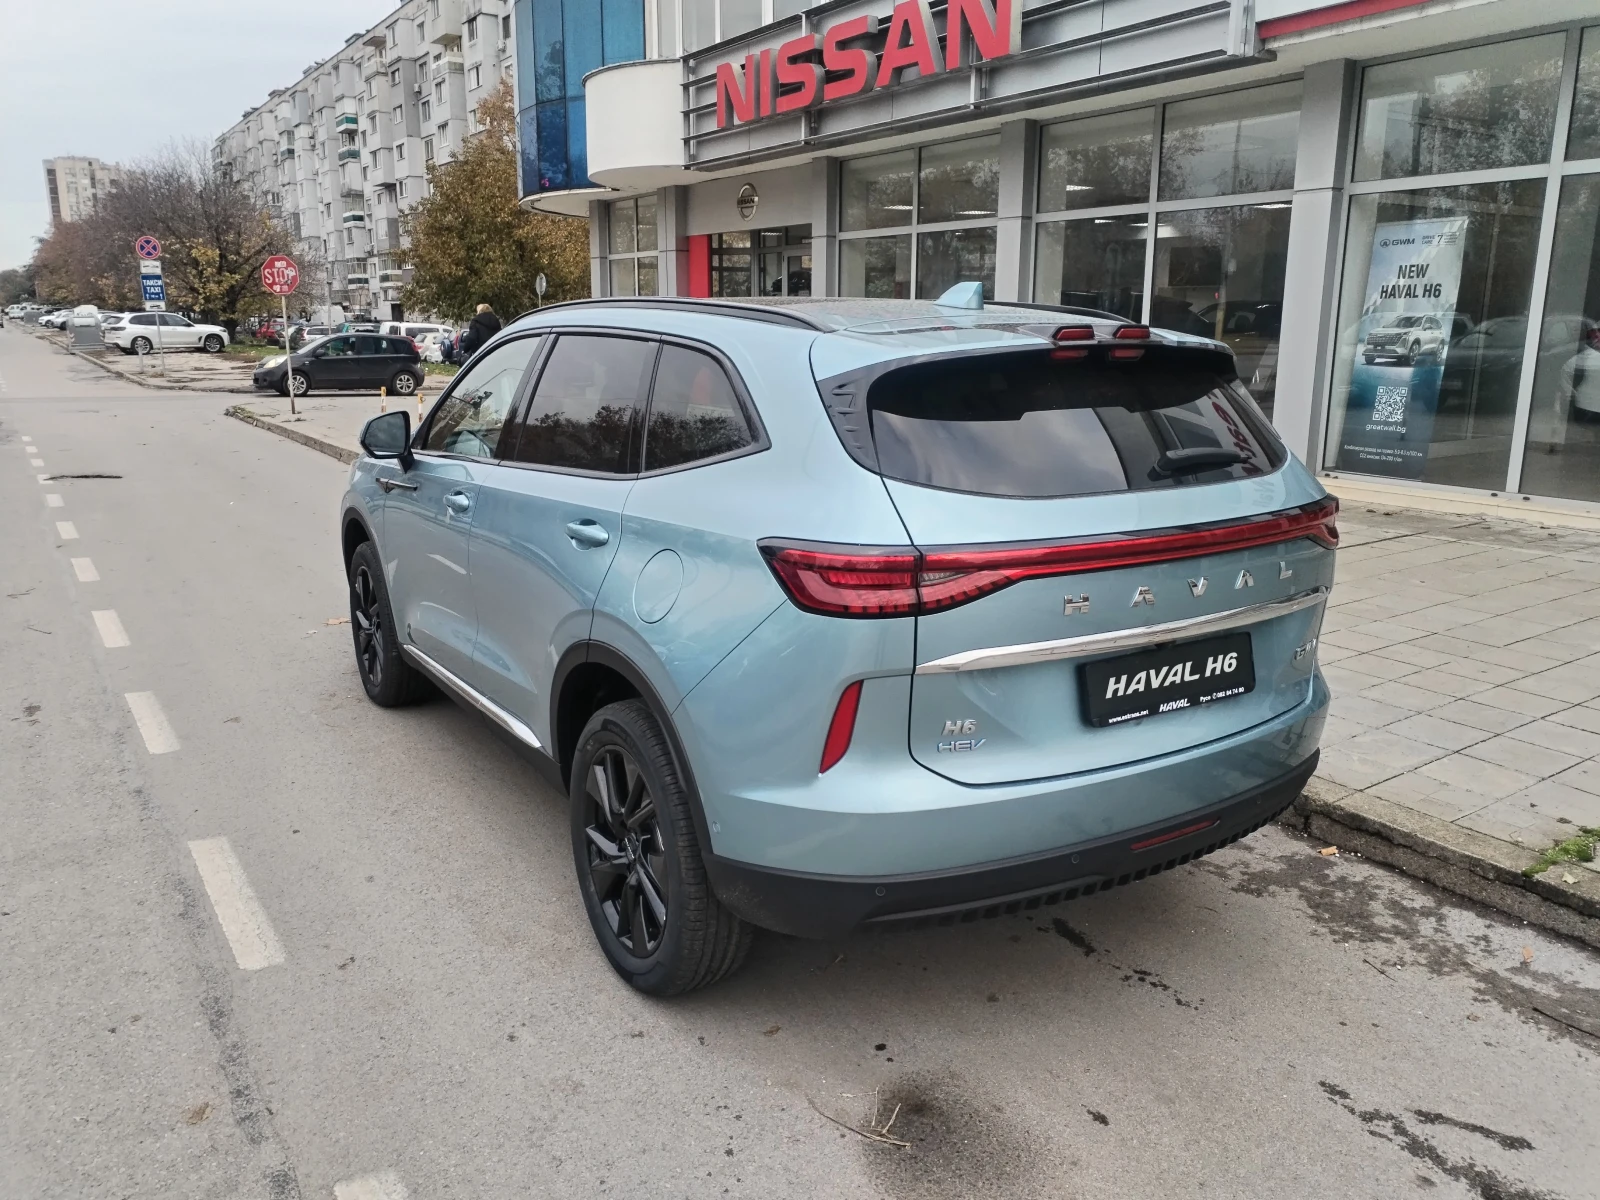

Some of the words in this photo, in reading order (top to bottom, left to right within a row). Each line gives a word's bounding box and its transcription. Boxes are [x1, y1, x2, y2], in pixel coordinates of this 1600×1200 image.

[716, 0, 1015, 129] NISSAN
[1391, 238, 1416, 246] GWM
[1397, 263, 1430, 280] NEW
[1380, 283, 1419, 300] HAVAL
[1422, 283, 1443, 299] H6
[1365, 424, 1407, 434] greatwall.bg
[1063, 561, 1293, 616] HAVAL
[1105, 661, 1200, 699] HAVAL
[1205, 652, 1238, 678] H6
[1159, 698, 1190, 713] HAVAL
[941, 719, 976, 736] H6
[937, 738, 986, 753] HEV
